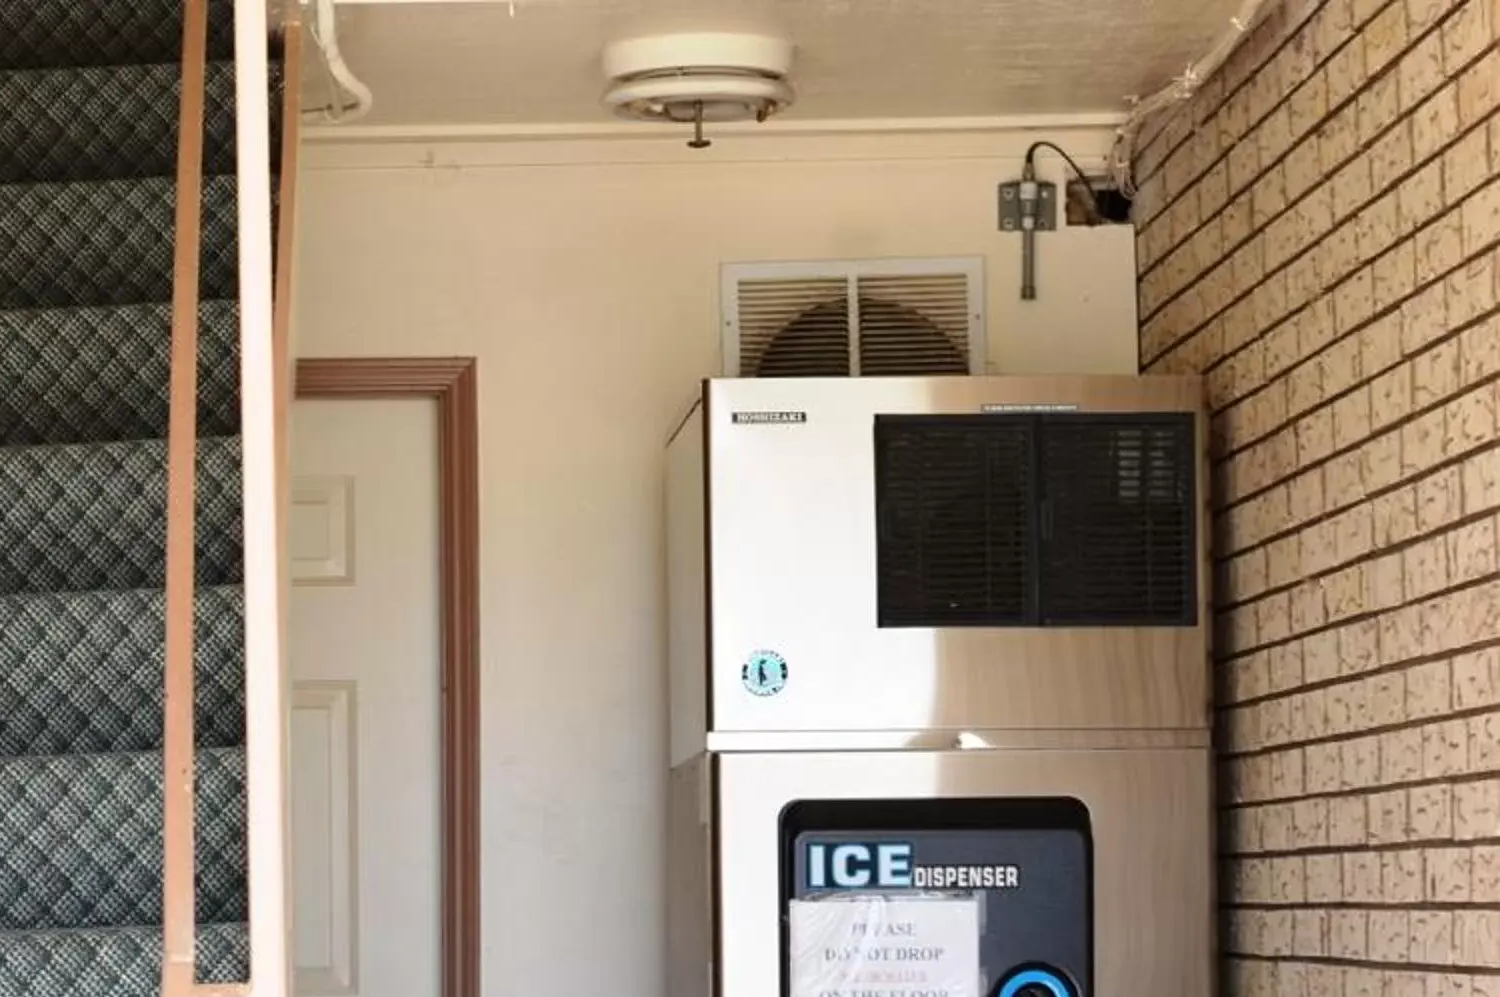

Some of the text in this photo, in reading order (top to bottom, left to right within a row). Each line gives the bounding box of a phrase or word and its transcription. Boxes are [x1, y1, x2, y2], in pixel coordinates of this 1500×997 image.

[810, 845, 1019, 887] ICE DISPENSER
[854, 948, 892, 962] OT
[896, 948, 945, 962] DROP
